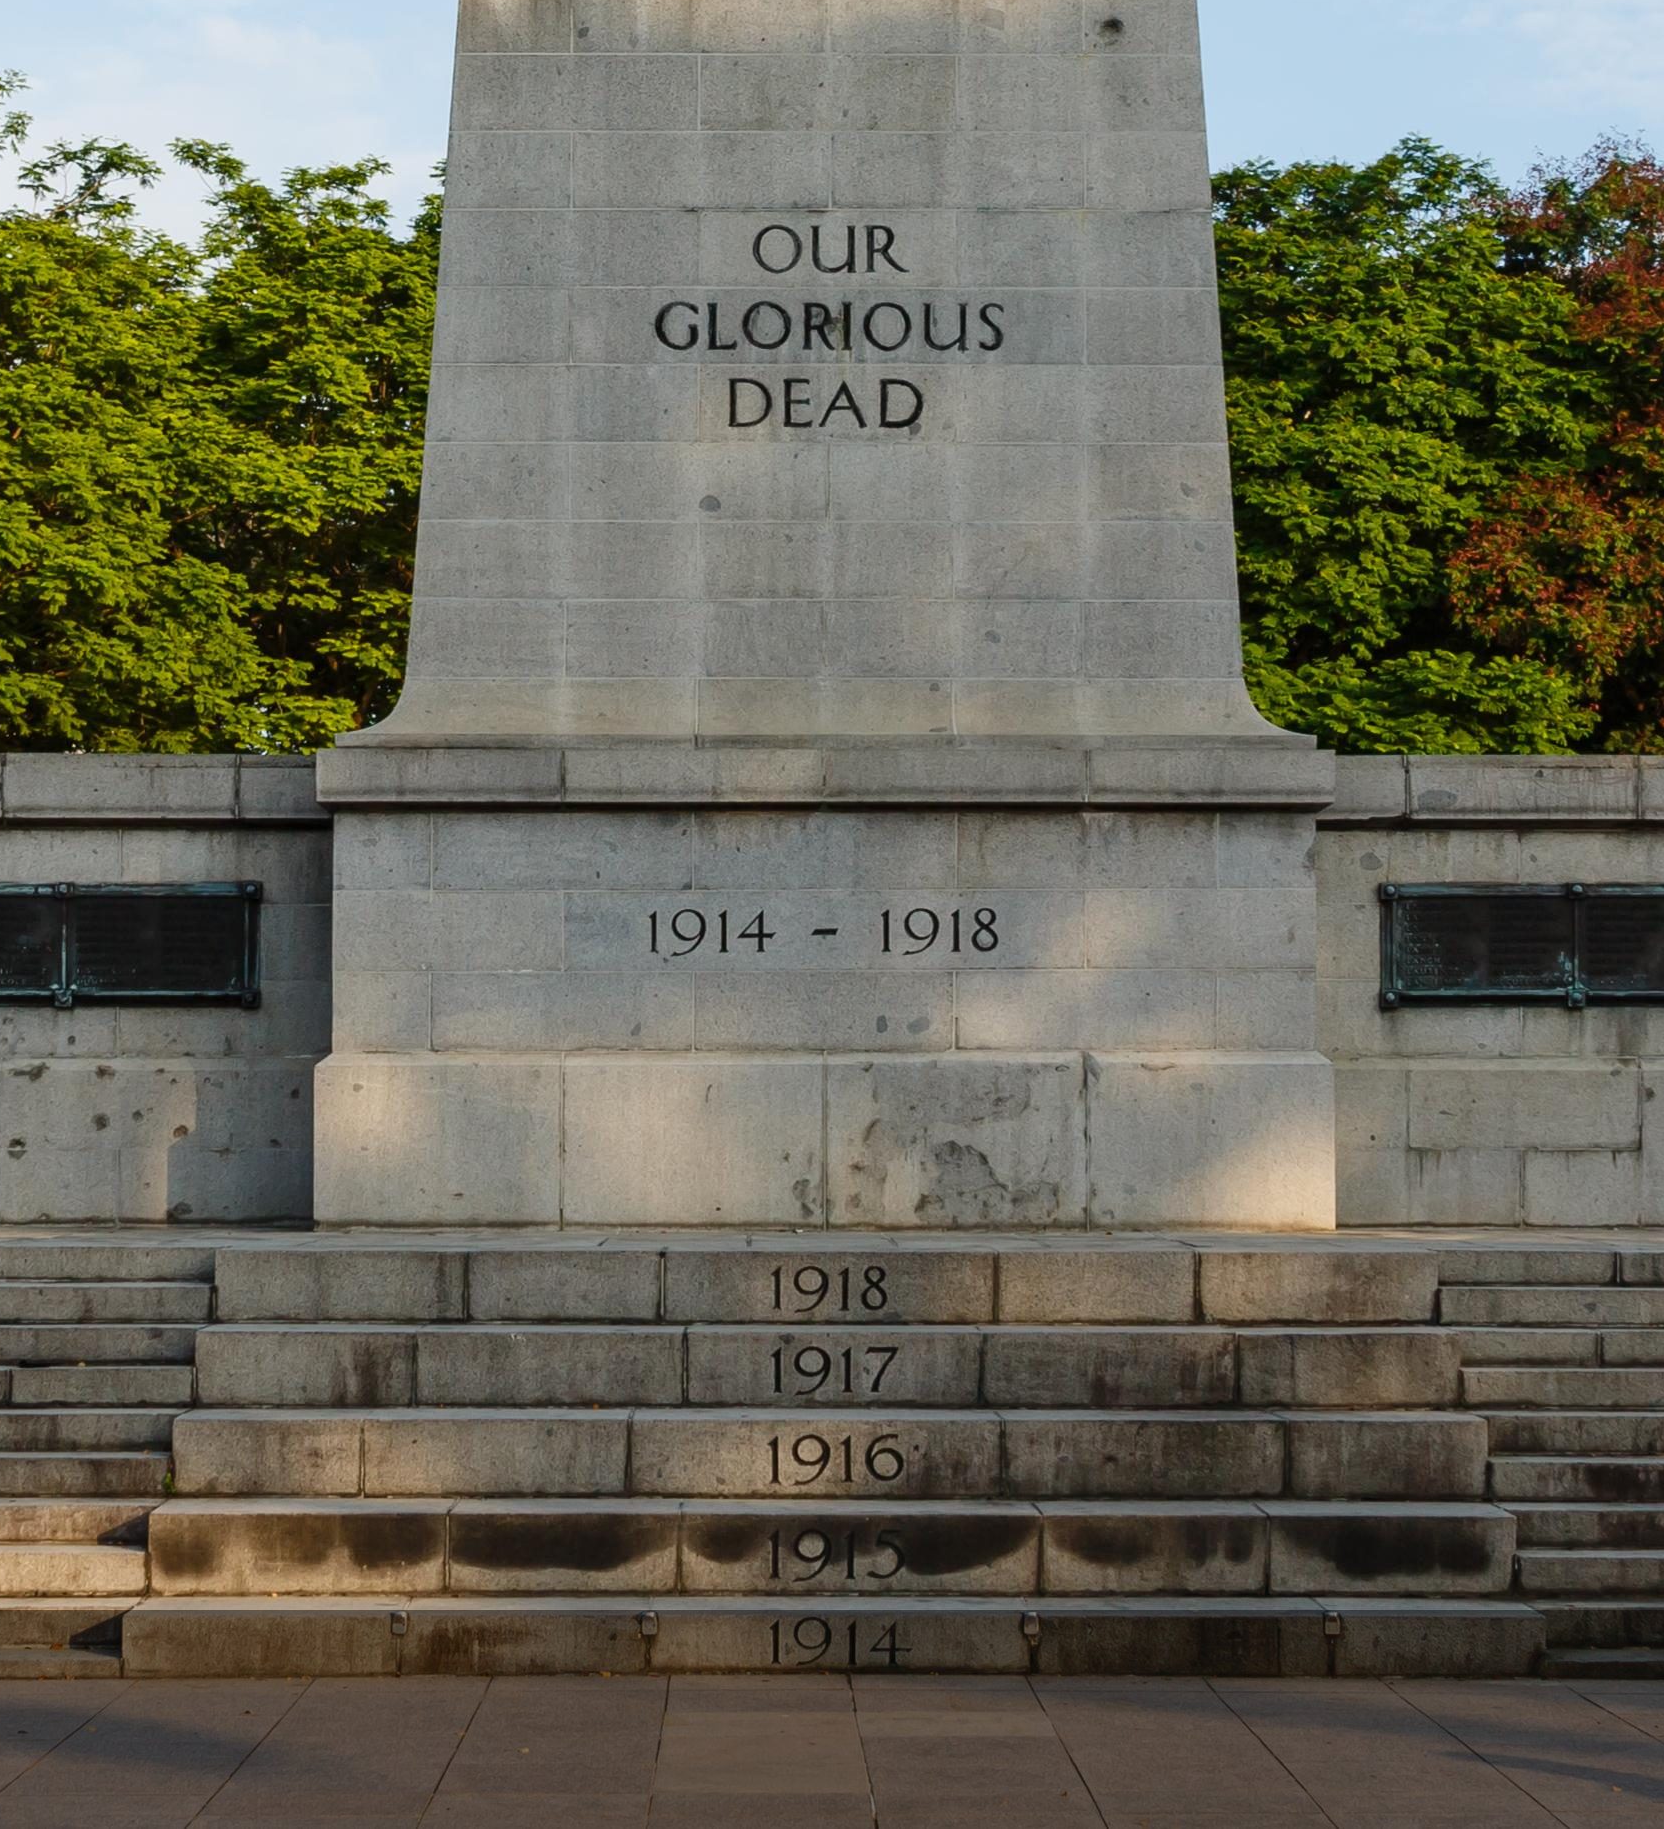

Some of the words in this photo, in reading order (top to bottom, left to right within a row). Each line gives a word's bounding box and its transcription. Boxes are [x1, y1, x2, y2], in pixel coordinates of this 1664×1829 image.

[752, 224, 910, 273] OUR
[654, 301, 1005, 351] GLORIOUS
[728, 378, 924, 429] DEAD
[648, 909, 777, 957] 1914
[880, 908, 999, 956] 1918
[770, 1265, 888, 1313] 1918
[770, 1346, 899, 1396] 1917
[767, 1433, 904, 1486] 1916
[767, 1529, 906, 1583] 1915
[768, 1617, 913, 1666] 1914
